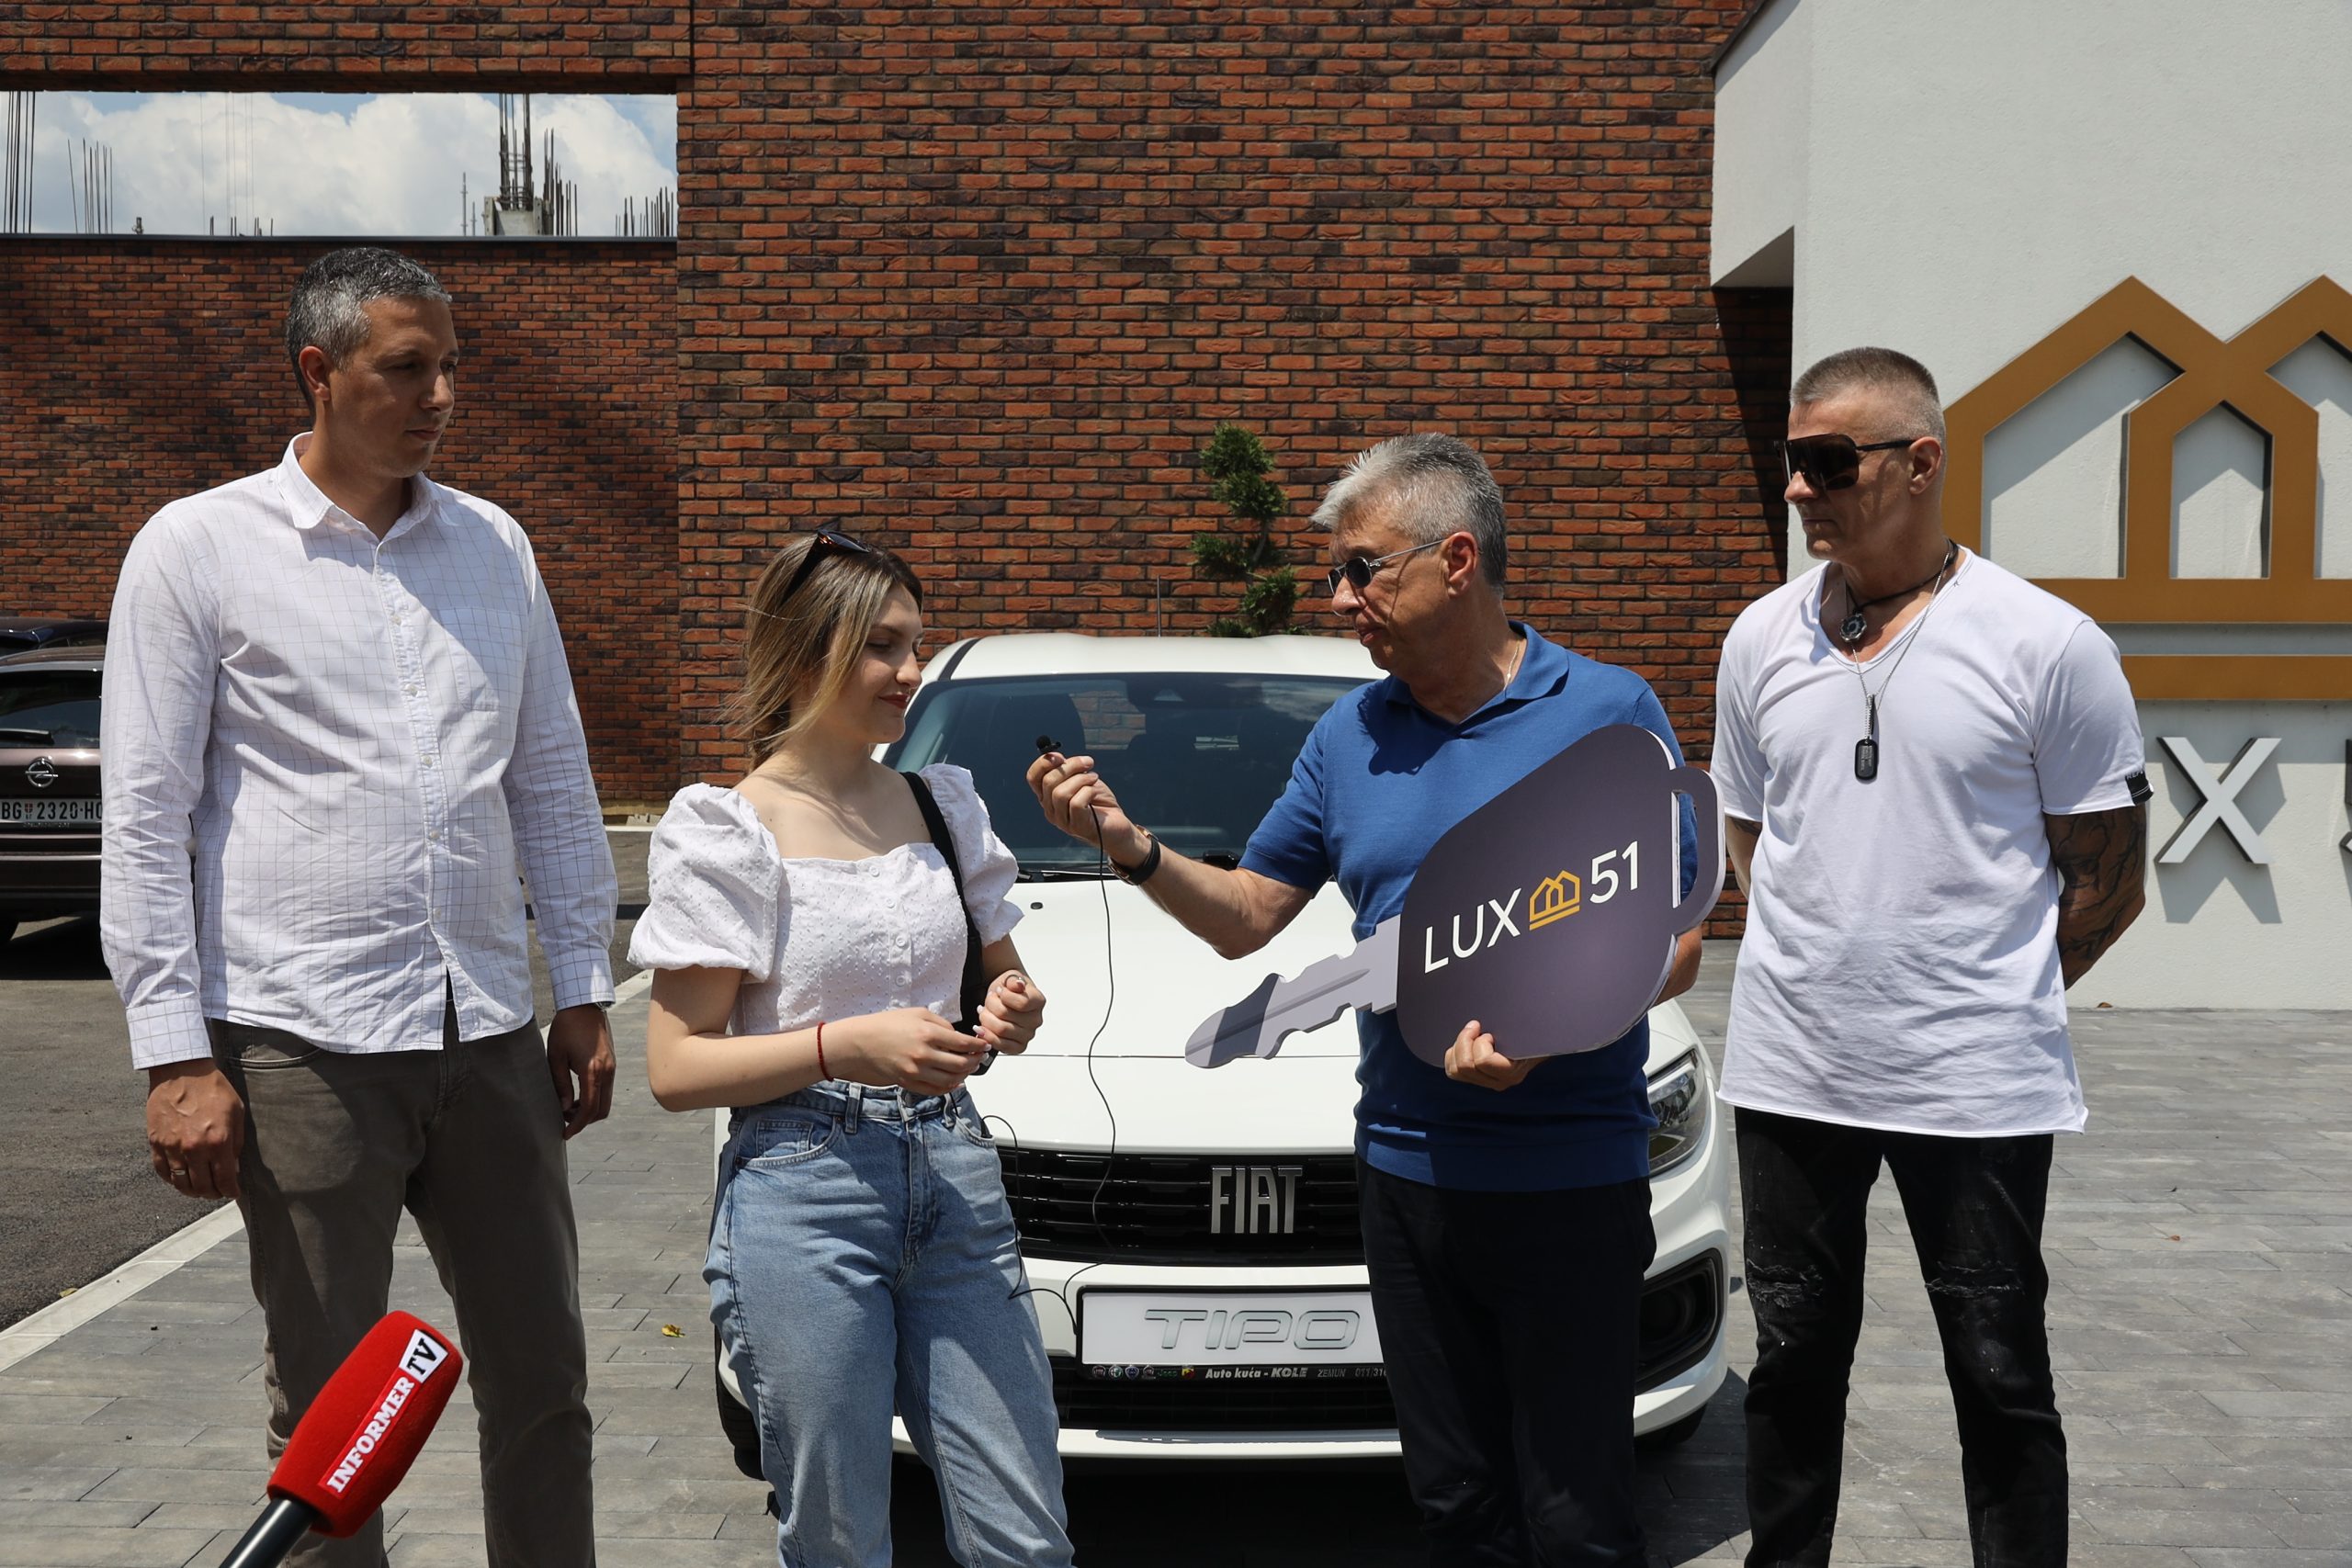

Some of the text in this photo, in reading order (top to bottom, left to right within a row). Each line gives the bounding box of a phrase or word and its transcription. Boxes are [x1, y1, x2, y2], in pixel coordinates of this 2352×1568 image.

[2, 801, 22, 819] BG
[1424, 840, 1639, 974] LUX 51
[1210, 1165, 1303, 1234] FIAT
[1144, 1309, 1361, 1350] TIPO
[1205, 1368, 1232, 1379] Auto
[1235, 1367, 1261, 1379] kuća
[1271, 1367, 1308, 1378] KOLE
[1317, 1368, 1347, 1378] ZEMUN
[326, 1338, 437, 1494] INFORMER TV
